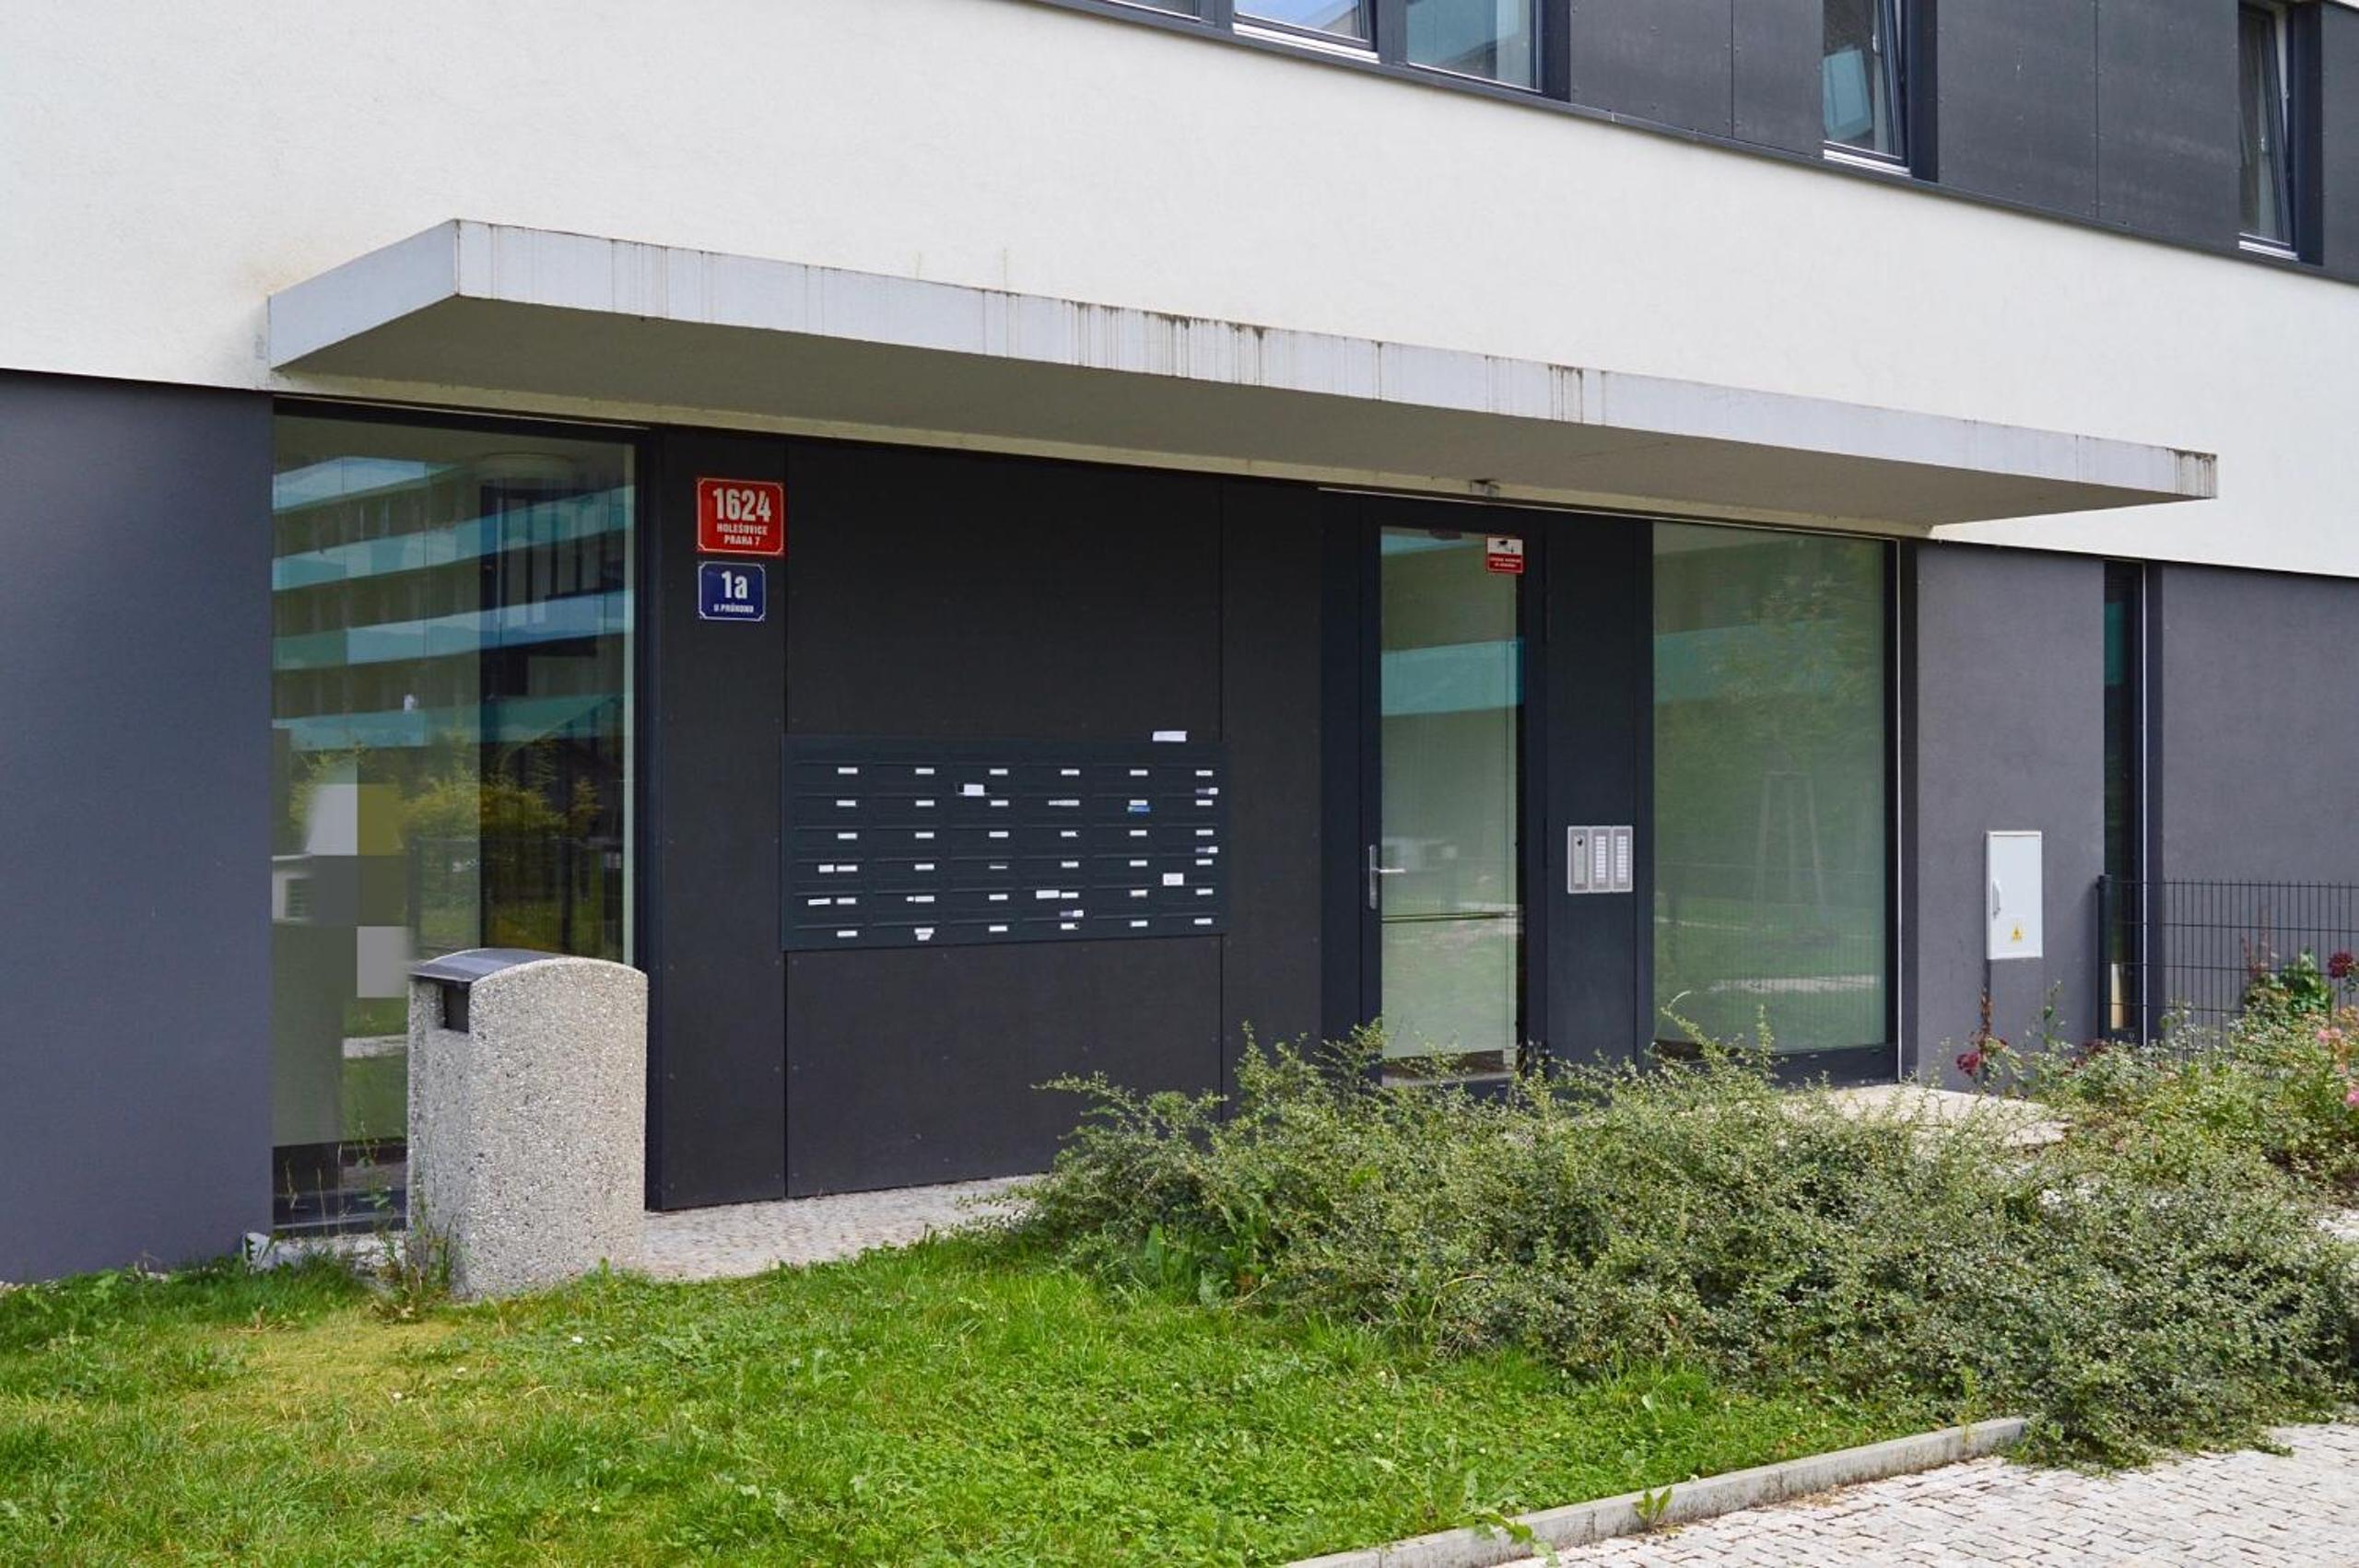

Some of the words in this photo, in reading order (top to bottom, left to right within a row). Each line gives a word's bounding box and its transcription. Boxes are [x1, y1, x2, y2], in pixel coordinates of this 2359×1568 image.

[712, 487, 771, 522] 1624
[723, 534, 753, 545] PRAHA
[754, 536, 760, 545] 7
[721, 570, 747, 599] 1a
